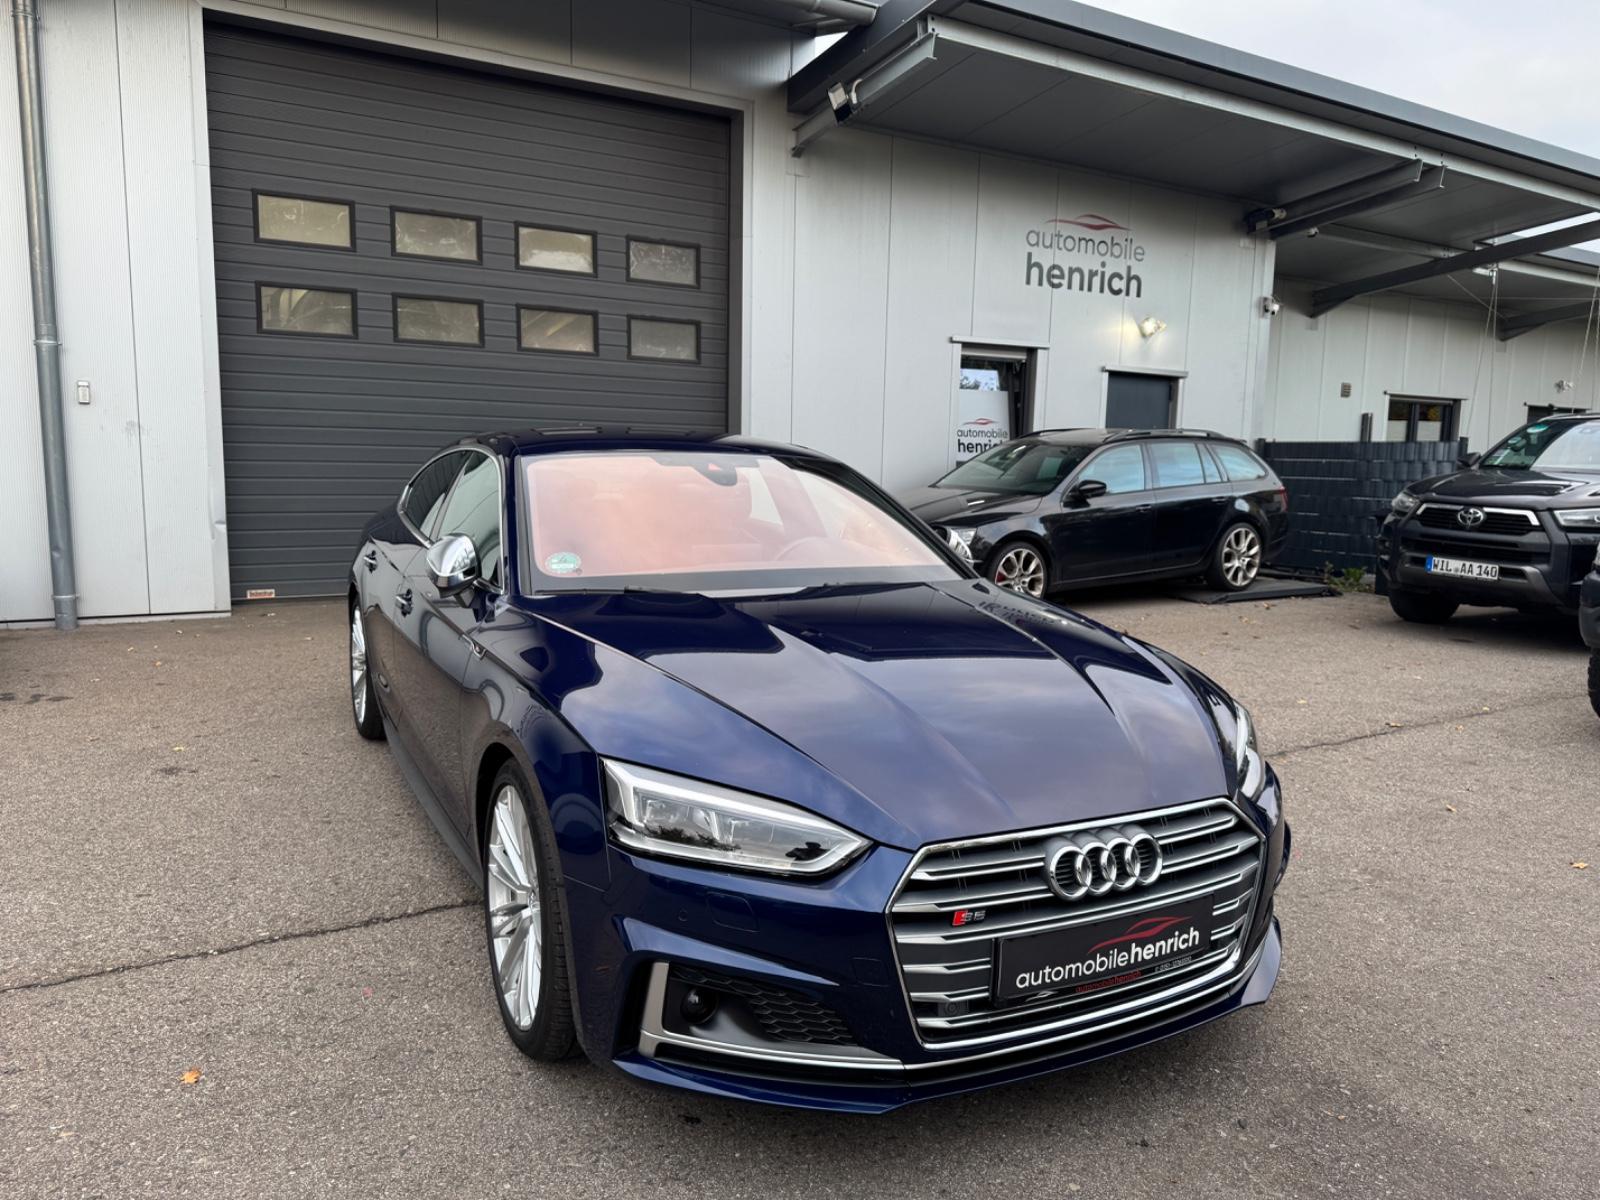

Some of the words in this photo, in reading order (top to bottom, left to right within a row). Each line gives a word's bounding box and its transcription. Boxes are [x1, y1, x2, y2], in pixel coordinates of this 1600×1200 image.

[1026, 229, 1146, 262] automobile
[1025, 251, 1143, 298] henrich
[957, 429, 1008, 439] automobile
[1460, 563, 1473, 575] AA
[1476, 565, 1497, 578] 140
